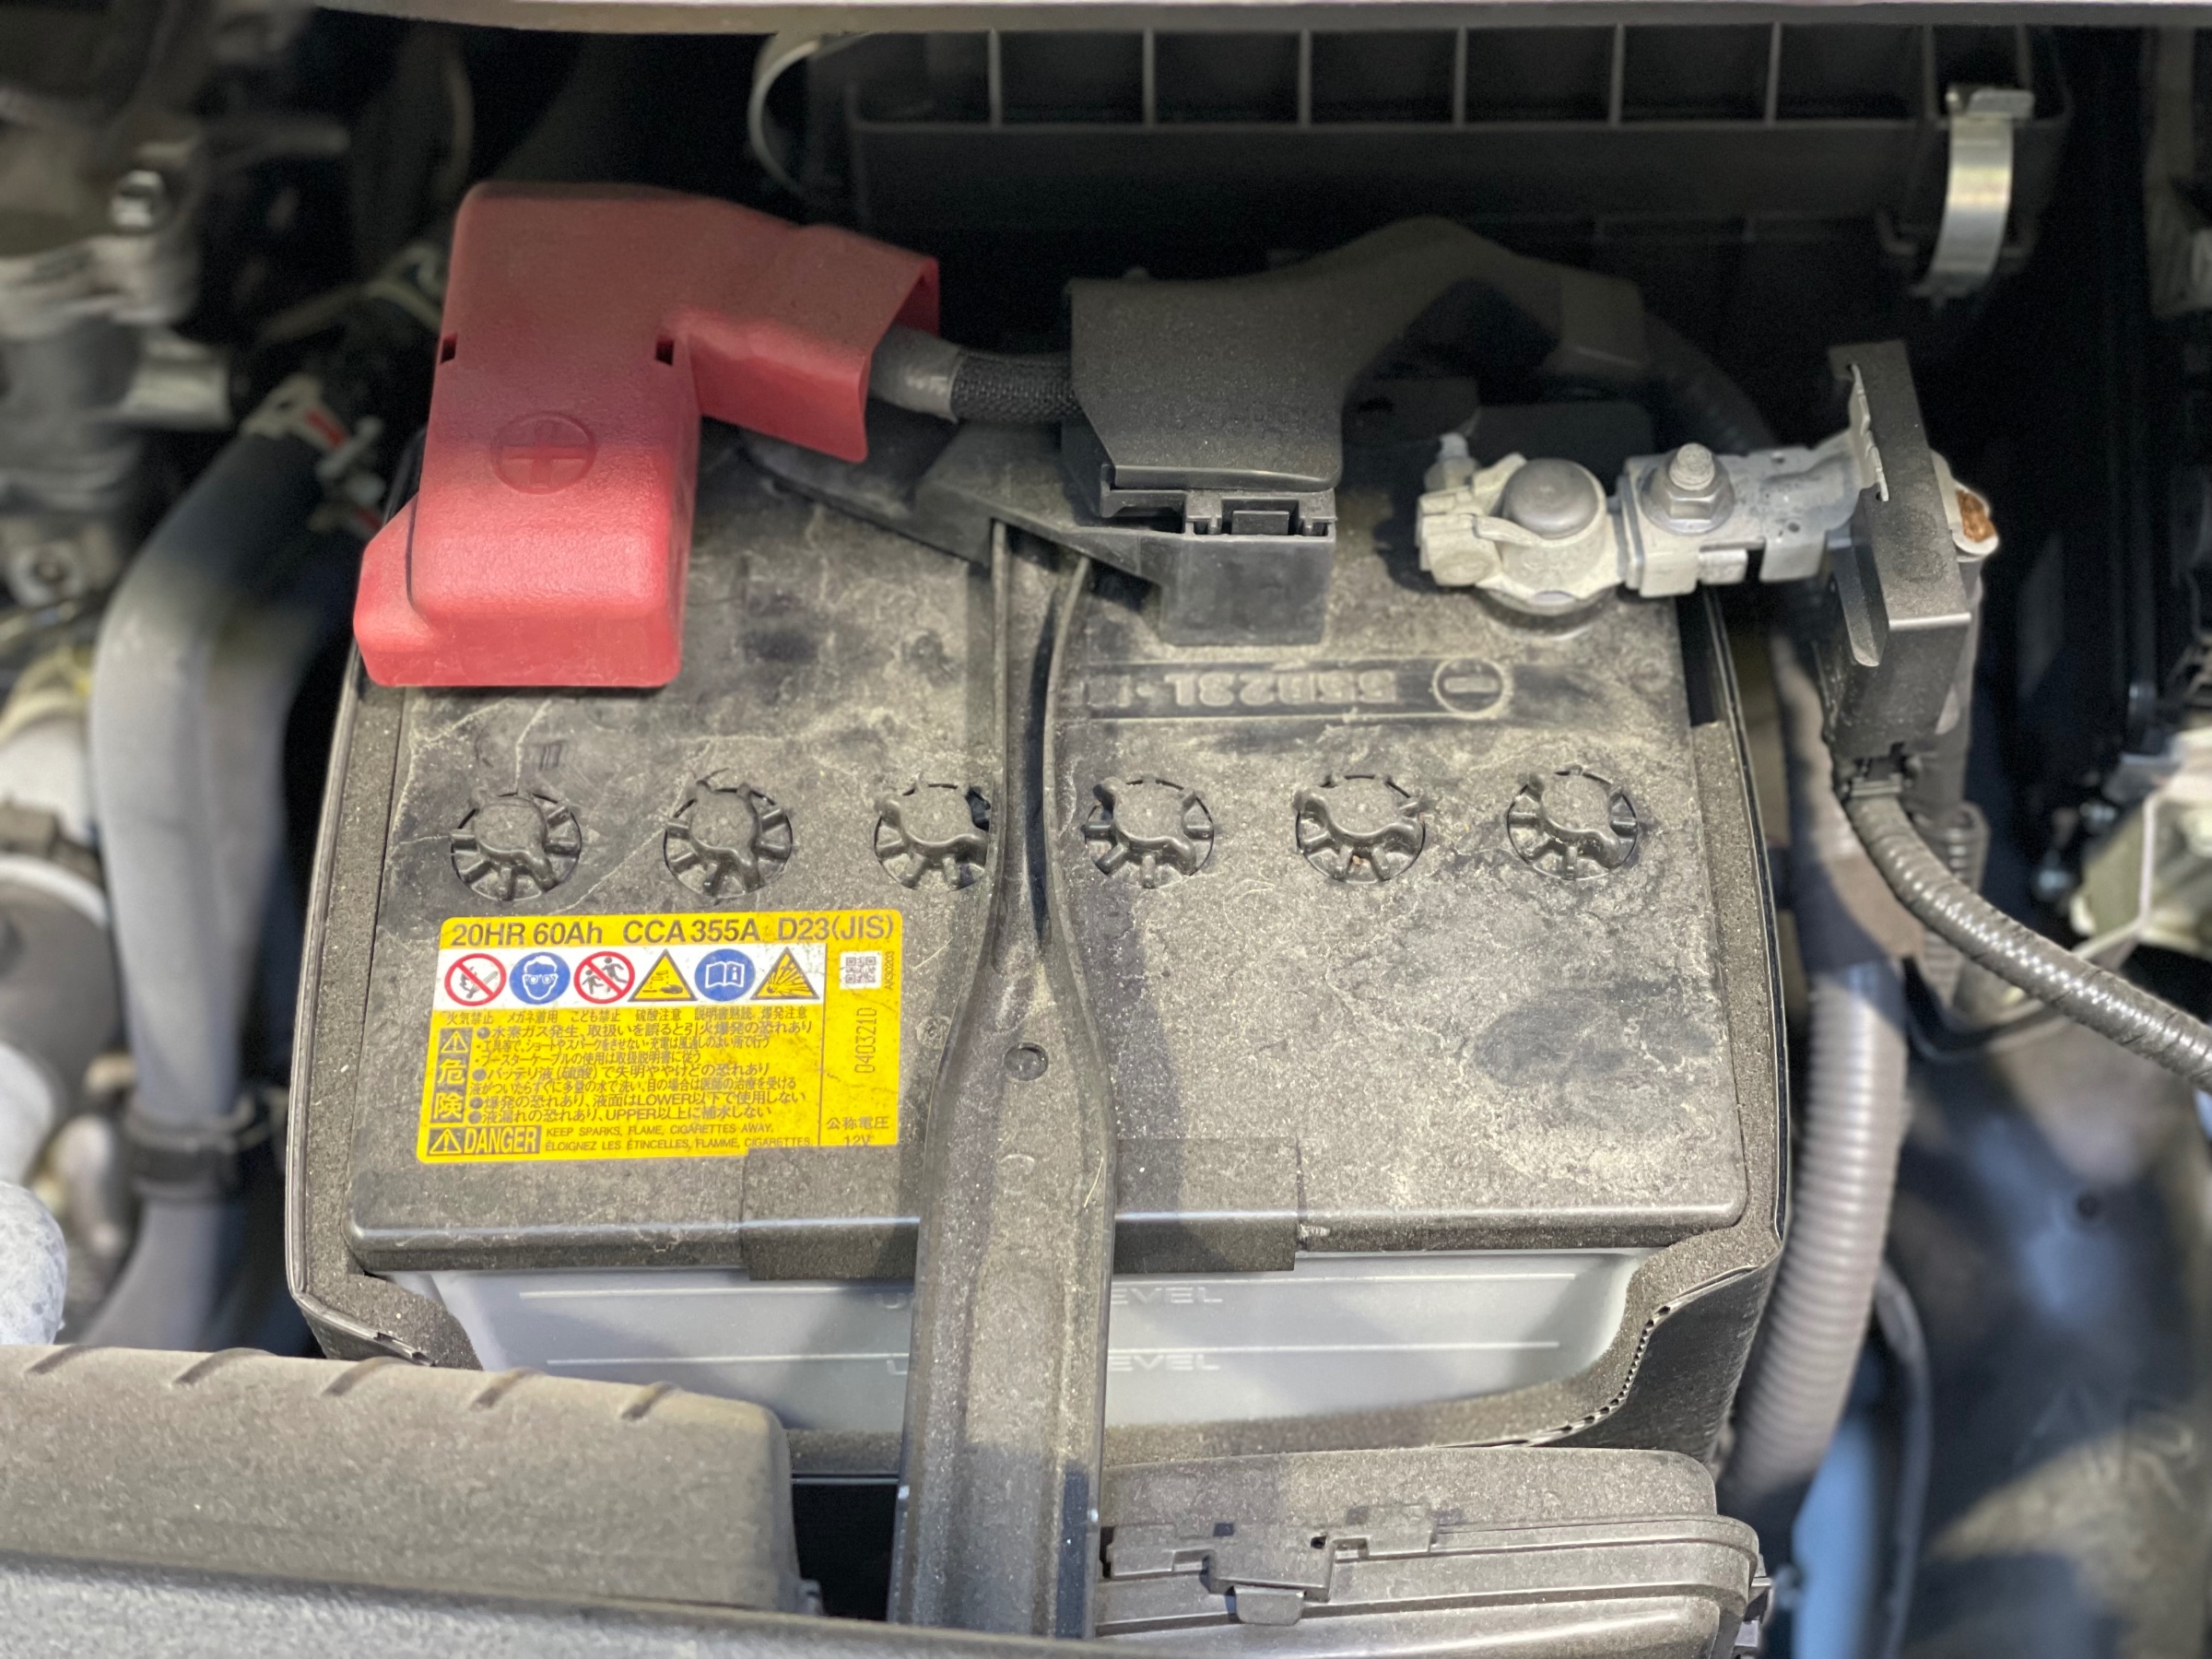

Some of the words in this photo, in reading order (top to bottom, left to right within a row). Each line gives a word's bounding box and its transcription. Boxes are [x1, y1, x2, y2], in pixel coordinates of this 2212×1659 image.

[451, 923, 526, 947] 20HR
[533, 922, 603, 945] 60Ah
[623, 919, 687, 943] CCA
[690, 918, 761, 942] 355A
[777, 915, 894, 940] D23(JIS)
[884, 950, 896, 991] AK30203
[447, 1011, 494, 1025] 火気禁止
[507, 1010, 559, 1024] メガネ着用
[571, 1009, 621, 1023] こども禁止
[635, 1008, 682, 1022] 硫酸注意
[694, 1006, 752, 1020] 説明書熟読
[761, 1006, 807, 1019] 爆発注意
[433, 1058, 466, 1121] 危険
[826, 1115, 889, 1131] 公称電圧
[546, 1127, 574, 1138] KEEP
[579, 1126, 623, 1138] SPARKS,
[628, 1124, 665, 1136] FLAME,
[670, 1124, 736, 1135] CIGARETTES
[464, 1126, 537, 1154] DANGER
[545, 1137, 597, 1151] ÉLOIGNEZ
[602, 1140, 621, 1151] LES
[843, 1134, 872, 1147] 12V
[1111, 1286, 1223, 1304] EVEL
[1107, 1353, 1220, 1371] EVEL
